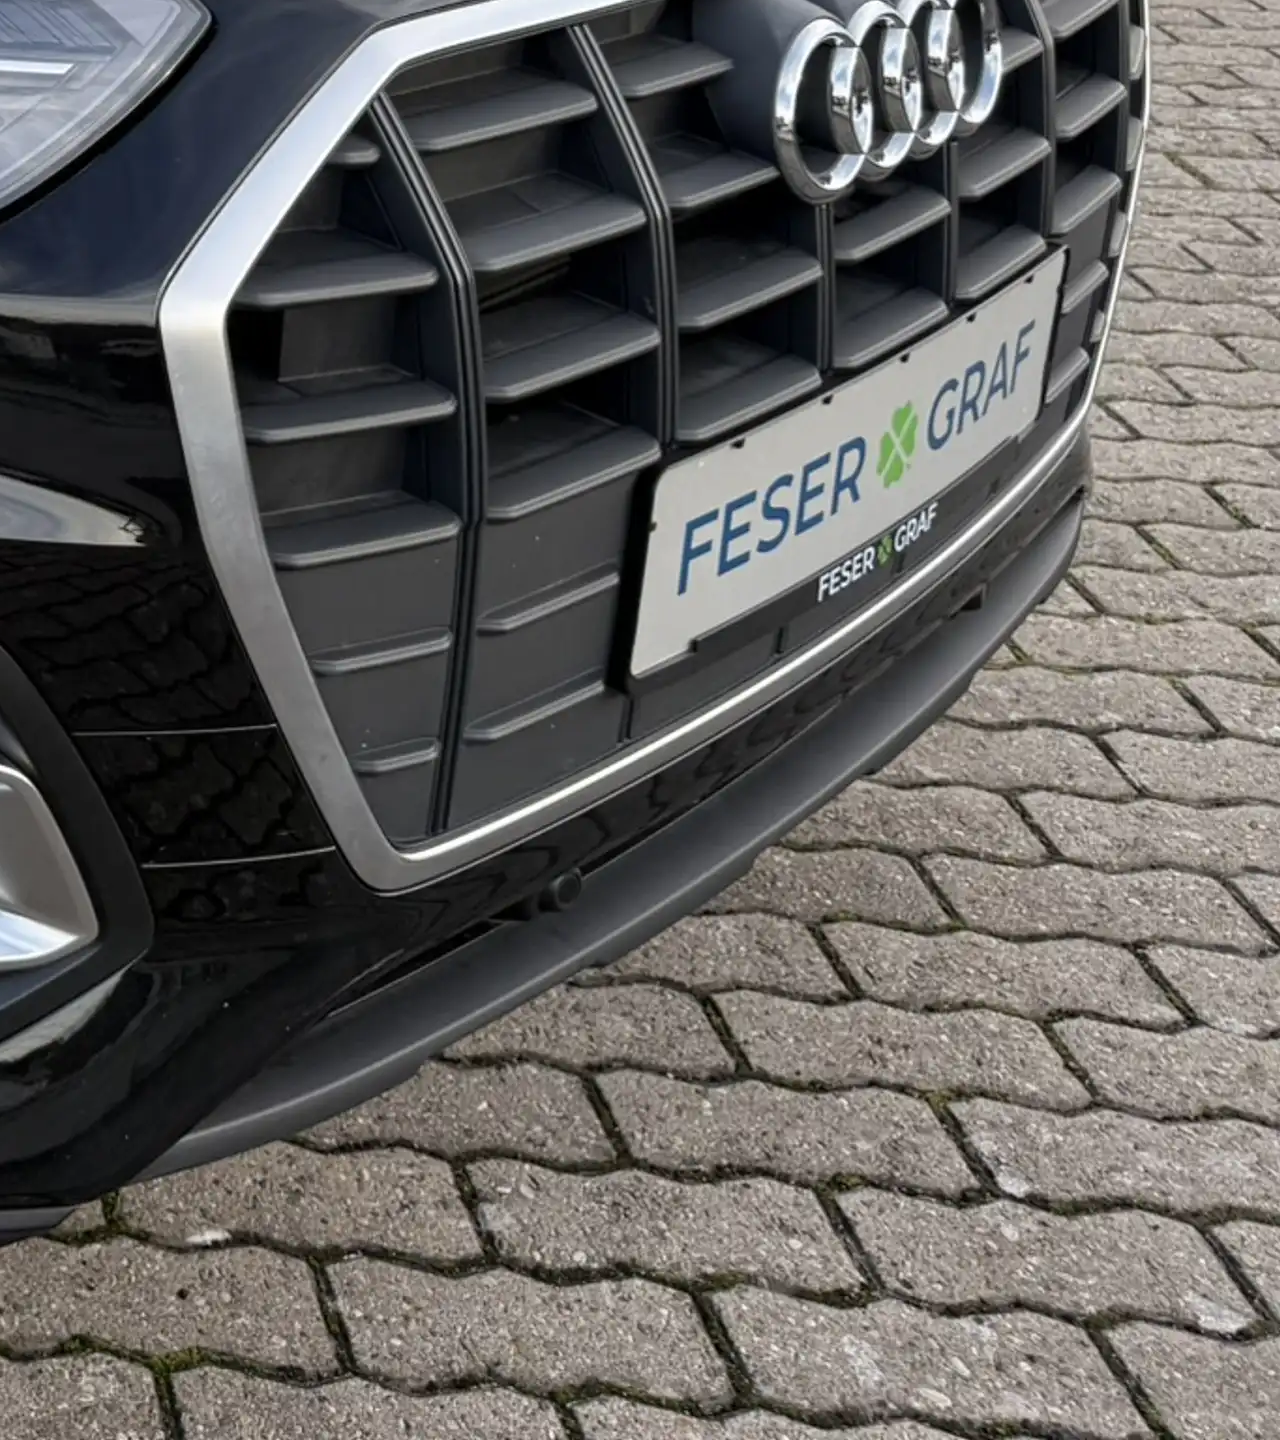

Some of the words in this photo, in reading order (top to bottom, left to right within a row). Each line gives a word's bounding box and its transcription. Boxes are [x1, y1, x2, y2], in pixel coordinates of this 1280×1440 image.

[677, 436, 867, 596] FESER
[927, 320, 1036, 451] GRAF
[817, 546, 875, 602] FESER
[893, 502, 939, 552] GRAF
